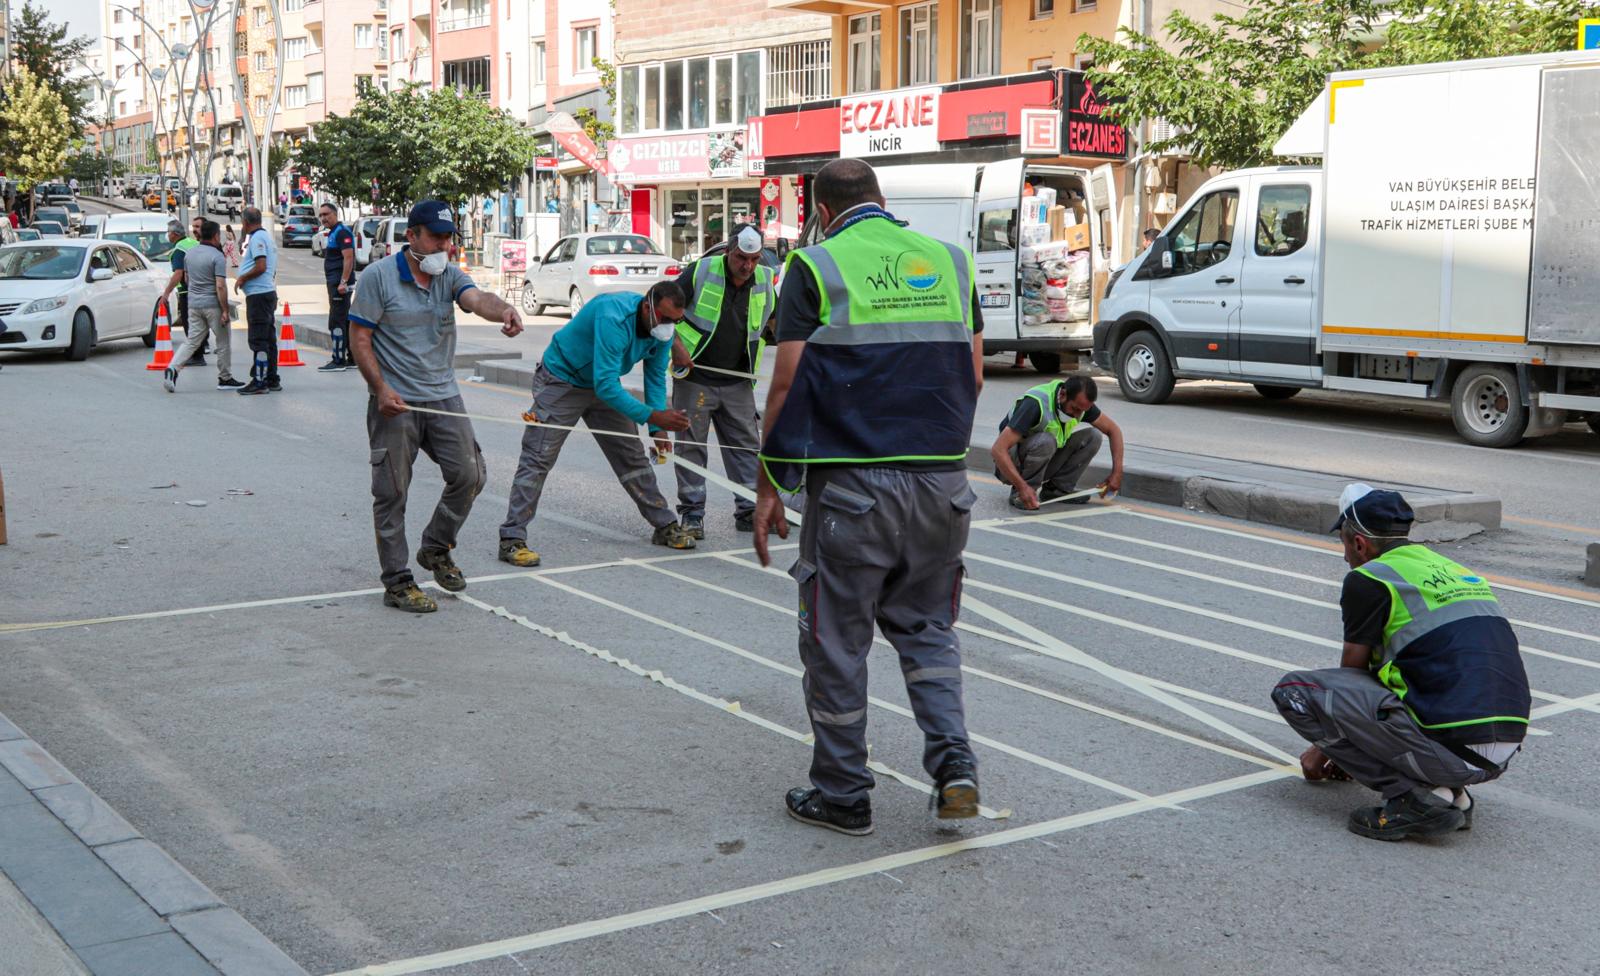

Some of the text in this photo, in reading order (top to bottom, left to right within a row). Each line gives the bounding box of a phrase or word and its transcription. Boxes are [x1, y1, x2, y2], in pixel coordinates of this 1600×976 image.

[841, 94, 934, 134] ECZANE
[869, 132, 902, 152] İNCİR
[1033, 120, 1052, 145] E
[1069, 121, 1126, 155] ECZANESİ
[1389, 182, 1413, 192] VAN
[1417, 177, 1497, 193] BÜYÜKŞEHİR
[1390, 200, 1435, 213] ULAŞIM
[1439, 196, 1489, 211] DAİRESİ
[1360, 217, 1403, 231] TRAFİK
[1407, 216, 1480, 231] HİZMETLERİ
[1484, 218, 1518, 232] ŞUBE
